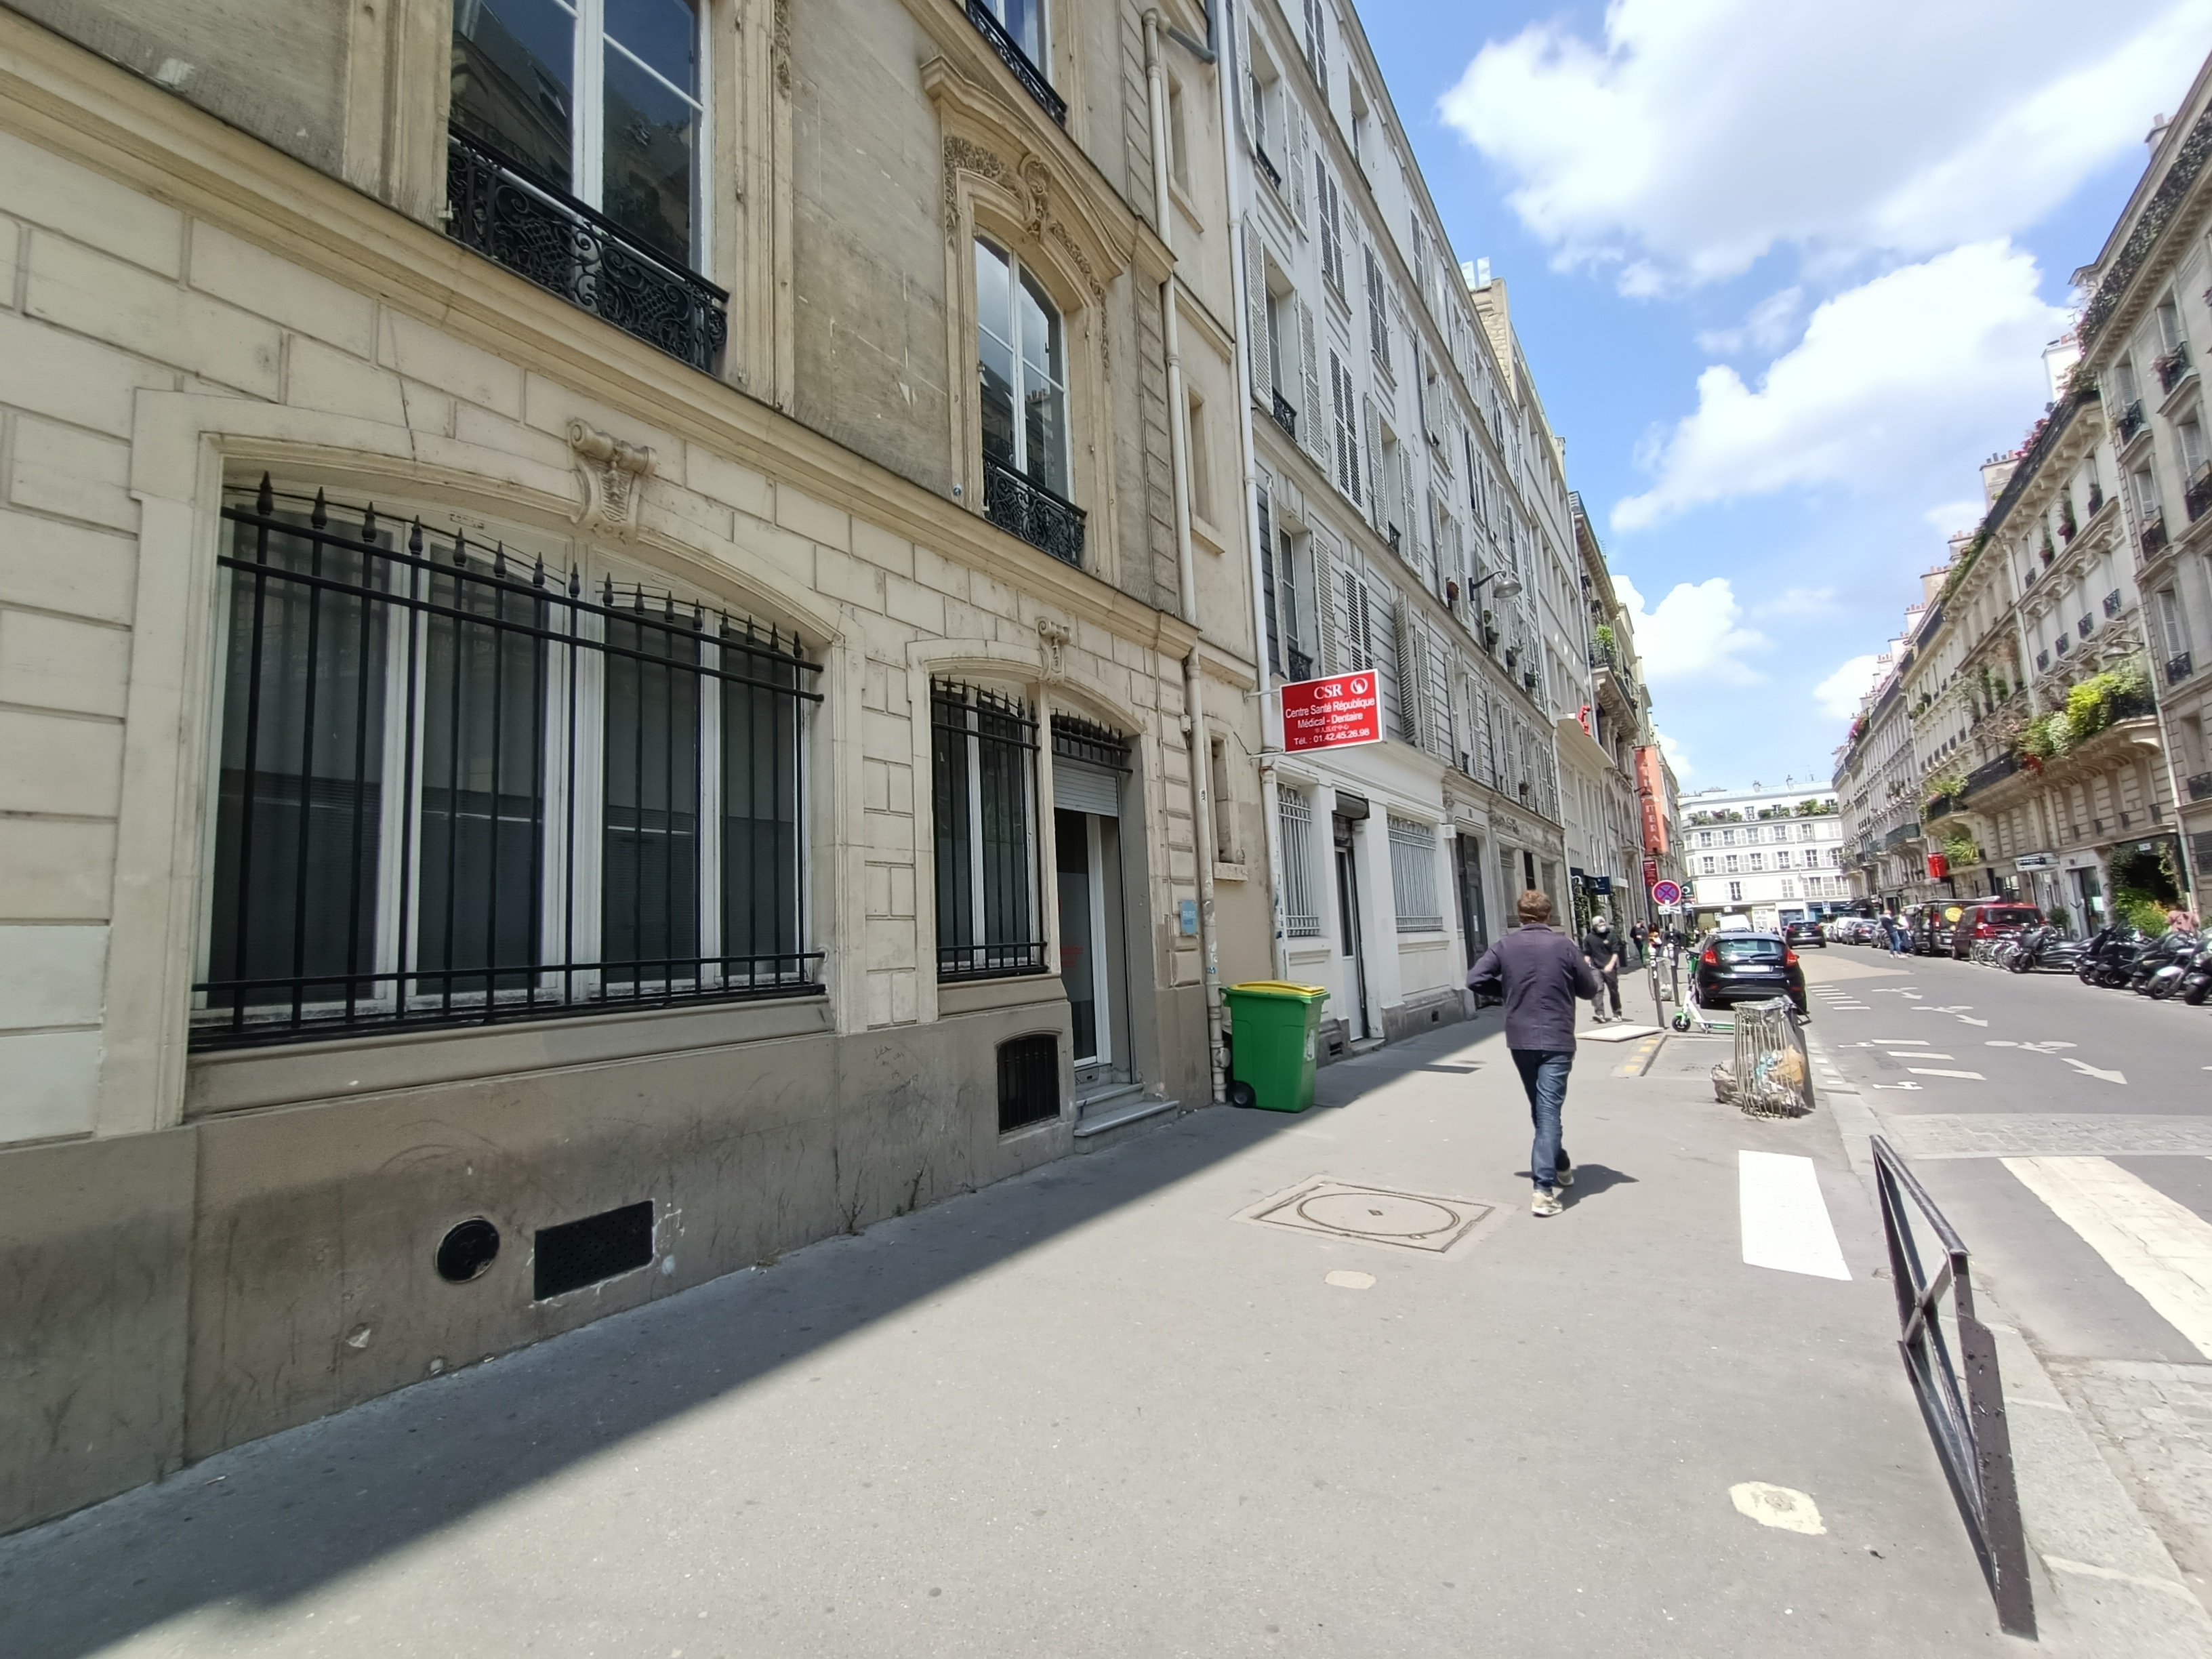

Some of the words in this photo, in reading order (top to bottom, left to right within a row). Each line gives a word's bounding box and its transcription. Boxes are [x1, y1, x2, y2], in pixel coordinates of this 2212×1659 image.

[1313, 684, 1343, 699] CSR
[1285, 706, 1309, 718] Centre
[1310, 702, 1332, 714] Santé
[1332, 697, 1375, 712] République
[1297, 716, 1326, 729] Médical
[1331, 712, 1364, 724] Dentaire
[1313, 728, 1370, 743] 01.42.45.26.98
